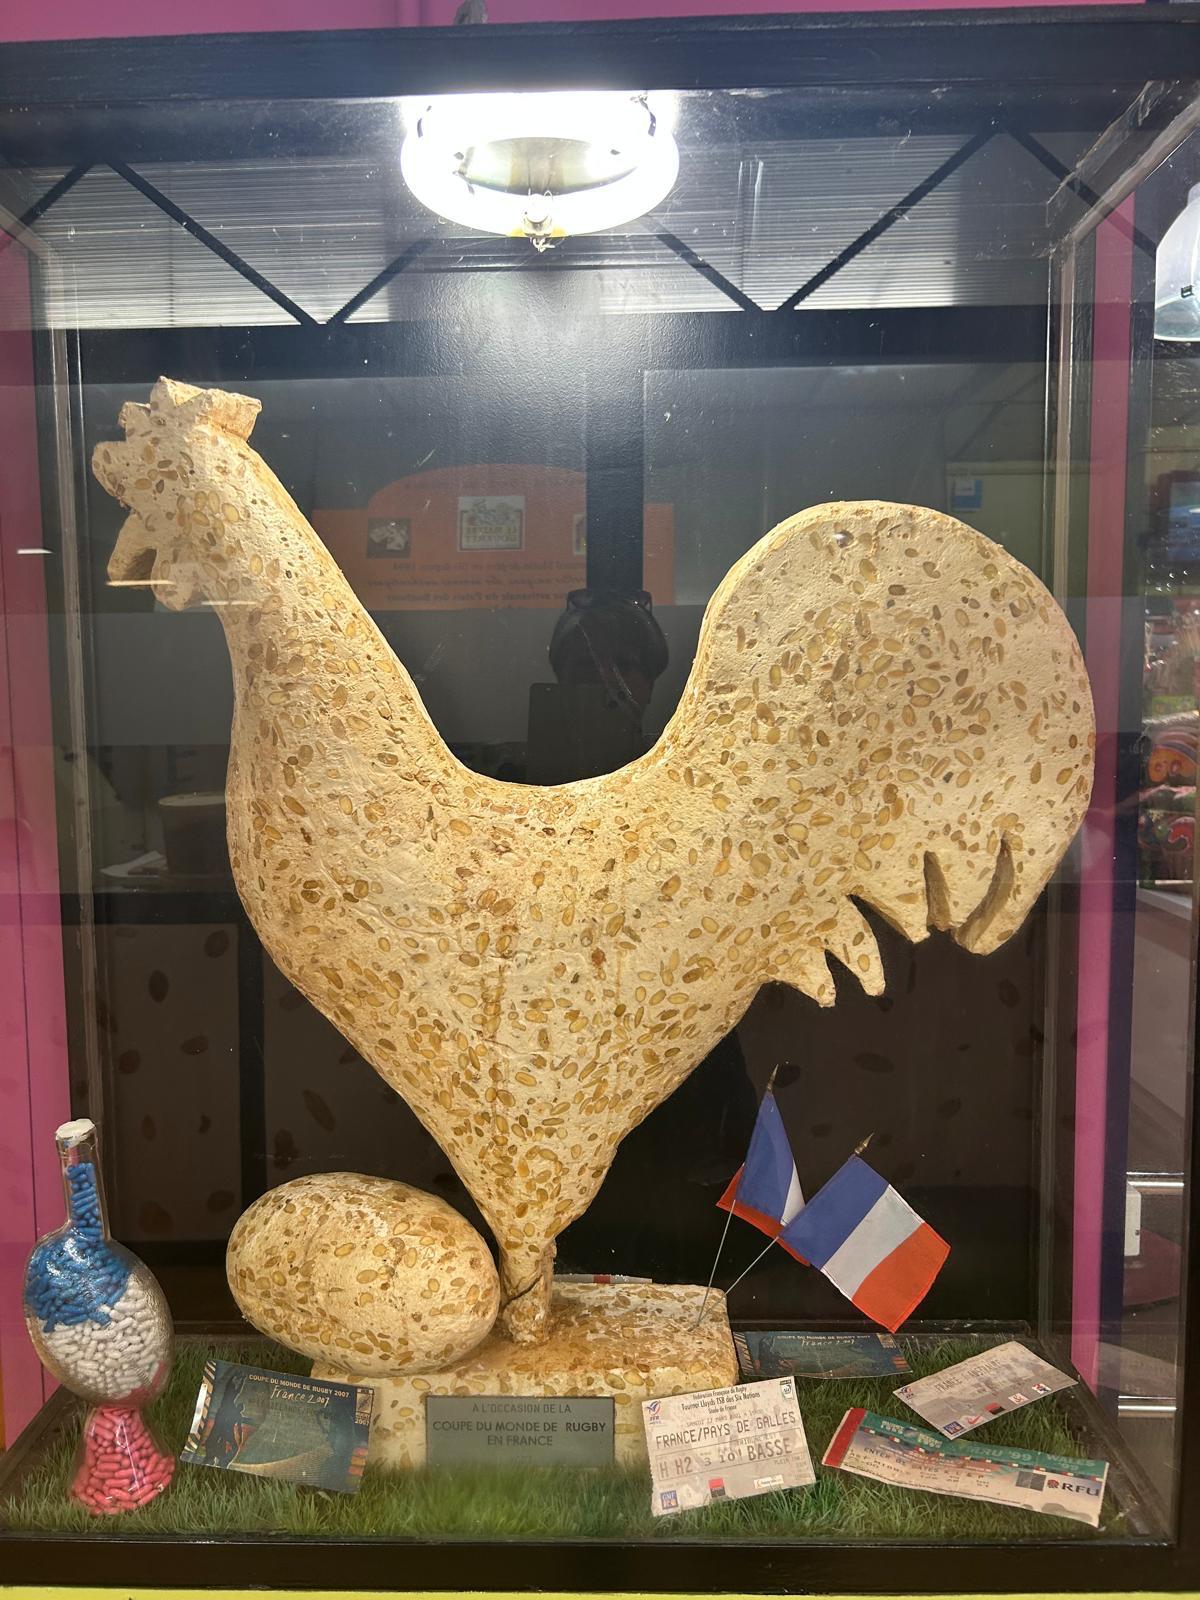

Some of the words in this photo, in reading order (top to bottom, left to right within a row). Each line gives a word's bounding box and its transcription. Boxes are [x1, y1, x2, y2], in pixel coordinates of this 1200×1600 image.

[249, 1374, 270, 1383] COUPE
[270, 1377, 279, 1385] DU
[279, 1379, 302, 1389] MONDE
[302, 1383, 311, 1391] DE
[312, 1385, 333, 1396] RUGBY
[334, 1390, 350, 1398] 2007
[270, 1385, 306, 1402] France
[482, 1403, 541, 1414] L'OCCASION
[543, 1403, 556, 1414] DE
[559, 1403, 572, 1414] LA
[681, 1401, 700, 1411] Tournoi
[700, 1399, 716, 1408] Lloyds
[725, 1395, 735, 1403] des
[735, 1394, 743, 1402] Six
[743, 1391, 761, 1400] Nations
[433, 1421, 473, 1432] COUPE
[476, 1421, 492, 1432] DU
[495, 1421, 540, 1432] MONDE
[543, 1421, 558, 1432] DE
[565, 1421, 607, 1433] RUGBY
[655, 1423, 731, 1449] FRANCE/PAYS
[736, 1420, 750, 1434] DE
[757, 1411, 797, 1430] GALLES
[487, 1435, 503, 1446] EN
[506, 1435, 553, 1446] FRANCE
[659, 1462, 669, 1478] H
[676, 1457, 693, 1476] H2
[704, 1457, 712, 1467] 3
[747, 1437, 793, 1461] BASSE
[1046, 1453, 1096, 1467] WALES
[1061, 1481, 1100, 1497] RFU
